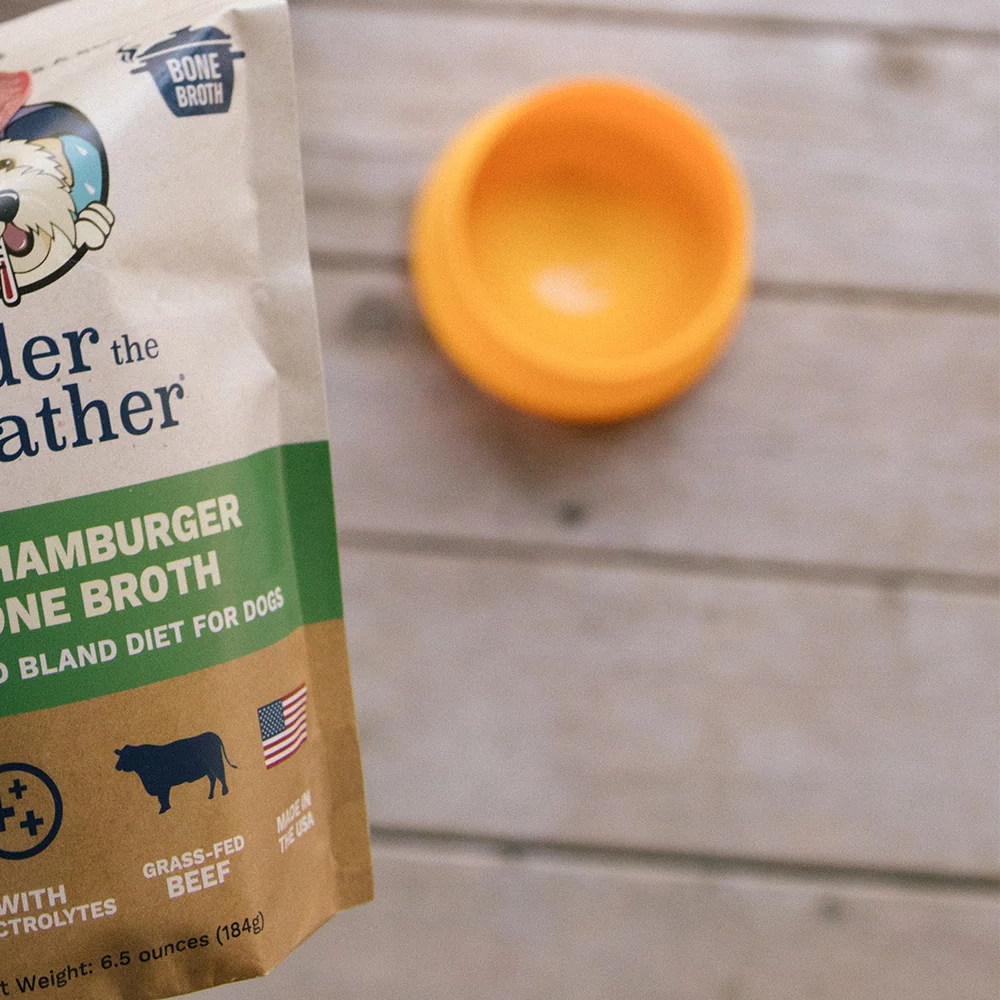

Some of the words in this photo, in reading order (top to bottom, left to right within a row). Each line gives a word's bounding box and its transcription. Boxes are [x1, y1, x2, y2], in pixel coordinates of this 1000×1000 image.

[166, 52, 222, 83] BONE
[175, 81, 224, 108] BROTH
[110, 334, 160, 365] the
[80, 550, 222, 618] BROTH
[19, 639, 118, 680] BLAND
[126, 621, 185, 656] DIET
[193, 605, 240, 639] FOR
[243, 586, 285, 623] DOGS
[276, 797, 301, 834] MADE
[279, 825, 295, 854] THE
[295, 811, 315, 838] USA
[142, 835, 245, 879] GRASS-FED
[166, 859, 231, 899] BEEF
[15, 961, 93, 993] Weight:
[101, 951, 131, 970] 6.5
[138, 934, 210, 963] ounces
[216, 911, 265, 945] (184g)
